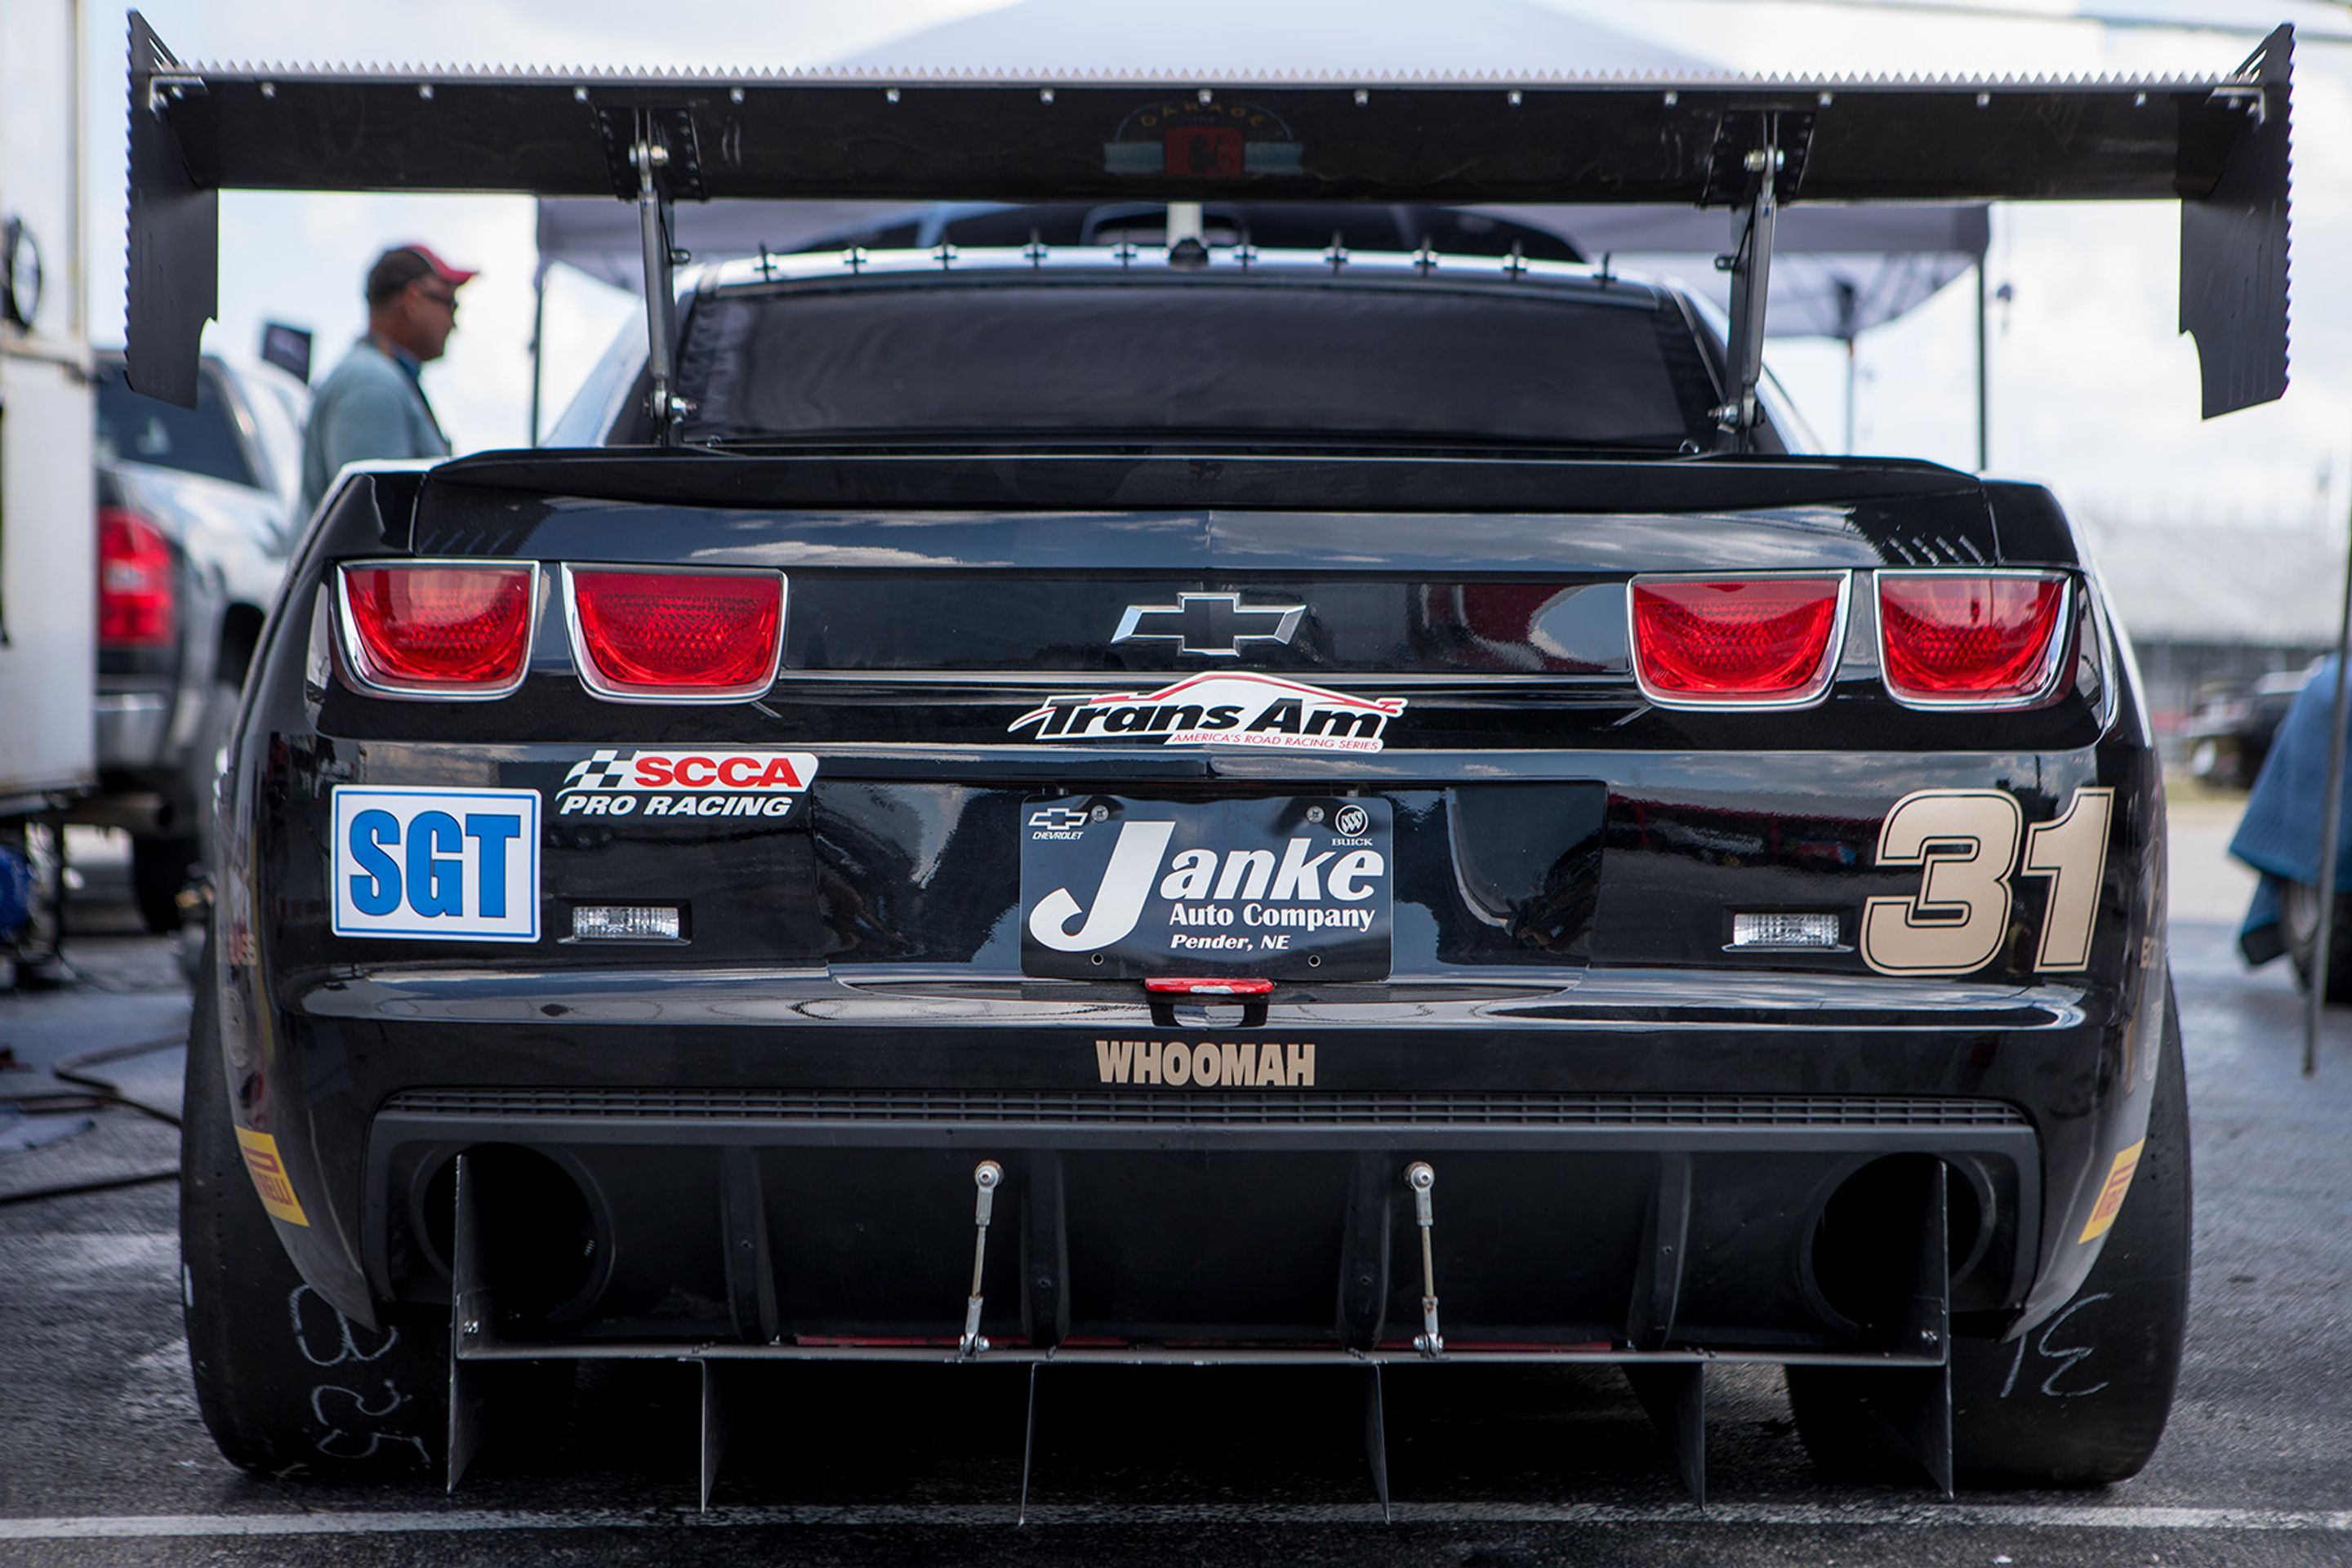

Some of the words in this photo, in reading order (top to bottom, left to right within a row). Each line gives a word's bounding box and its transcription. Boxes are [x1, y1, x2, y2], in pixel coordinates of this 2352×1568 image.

[1032, 696, 1240, 736] Trans
[1242, 697, 1383, 739] Am
[1172, 732, 1241, 744] AMERICA'S
[1243, 734, 1282, 746] ROAD
[1284, 737, 1336, 750] RACING
[1338, 741, 1379, 752] SERIES
[634, 756, 803, 788] SCCA
[559, 795, 638, 816] PRO
[643, 795, 793, 817] RACING
[1031, 831, 1085, 841] CHEVROLET
[1331, 837, 1374, 847] BUICK
[348, 808, 522, 919] SGT
[1028, 821, 1385, 952] Janke
[1860, 786, 2116, 977] 31
[1169, 902, 1235, 927] Auto
[1242, 903, 1376, 932] Company
[1170, 934, 1254, 952] Pender,
[1260, 935, 1290, 951] NE
[1095, 1040, 1316, 1088] WHOOMAH
